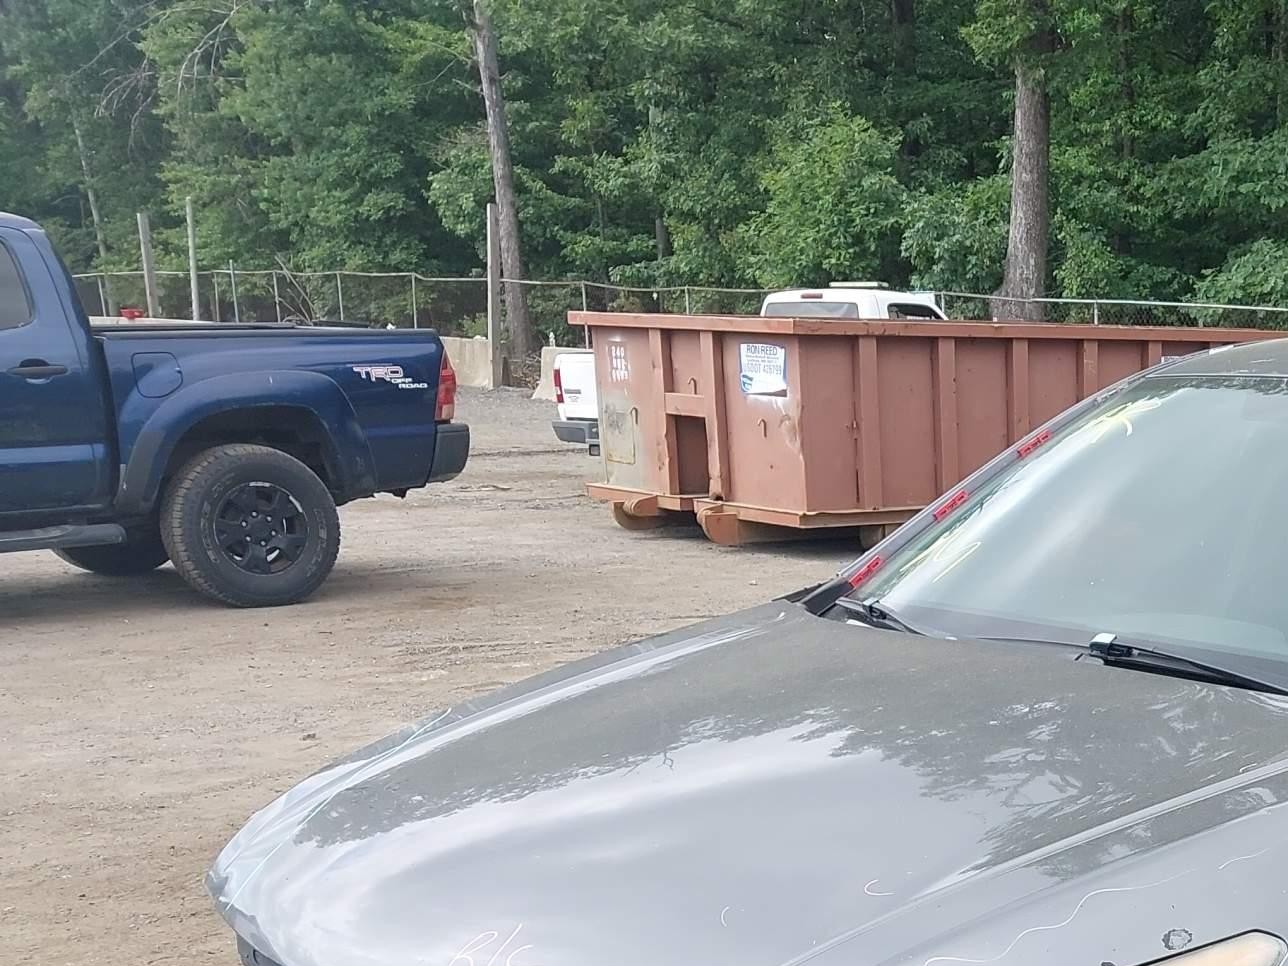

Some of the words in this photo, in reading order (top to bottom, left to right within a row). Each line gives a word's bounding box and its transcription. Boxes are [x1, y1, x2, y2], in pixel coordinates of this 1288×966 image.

[746, 345, 760, 354] RON
[760, 345, 778, 356] REED
[352, 364, 404, 383] TRD
